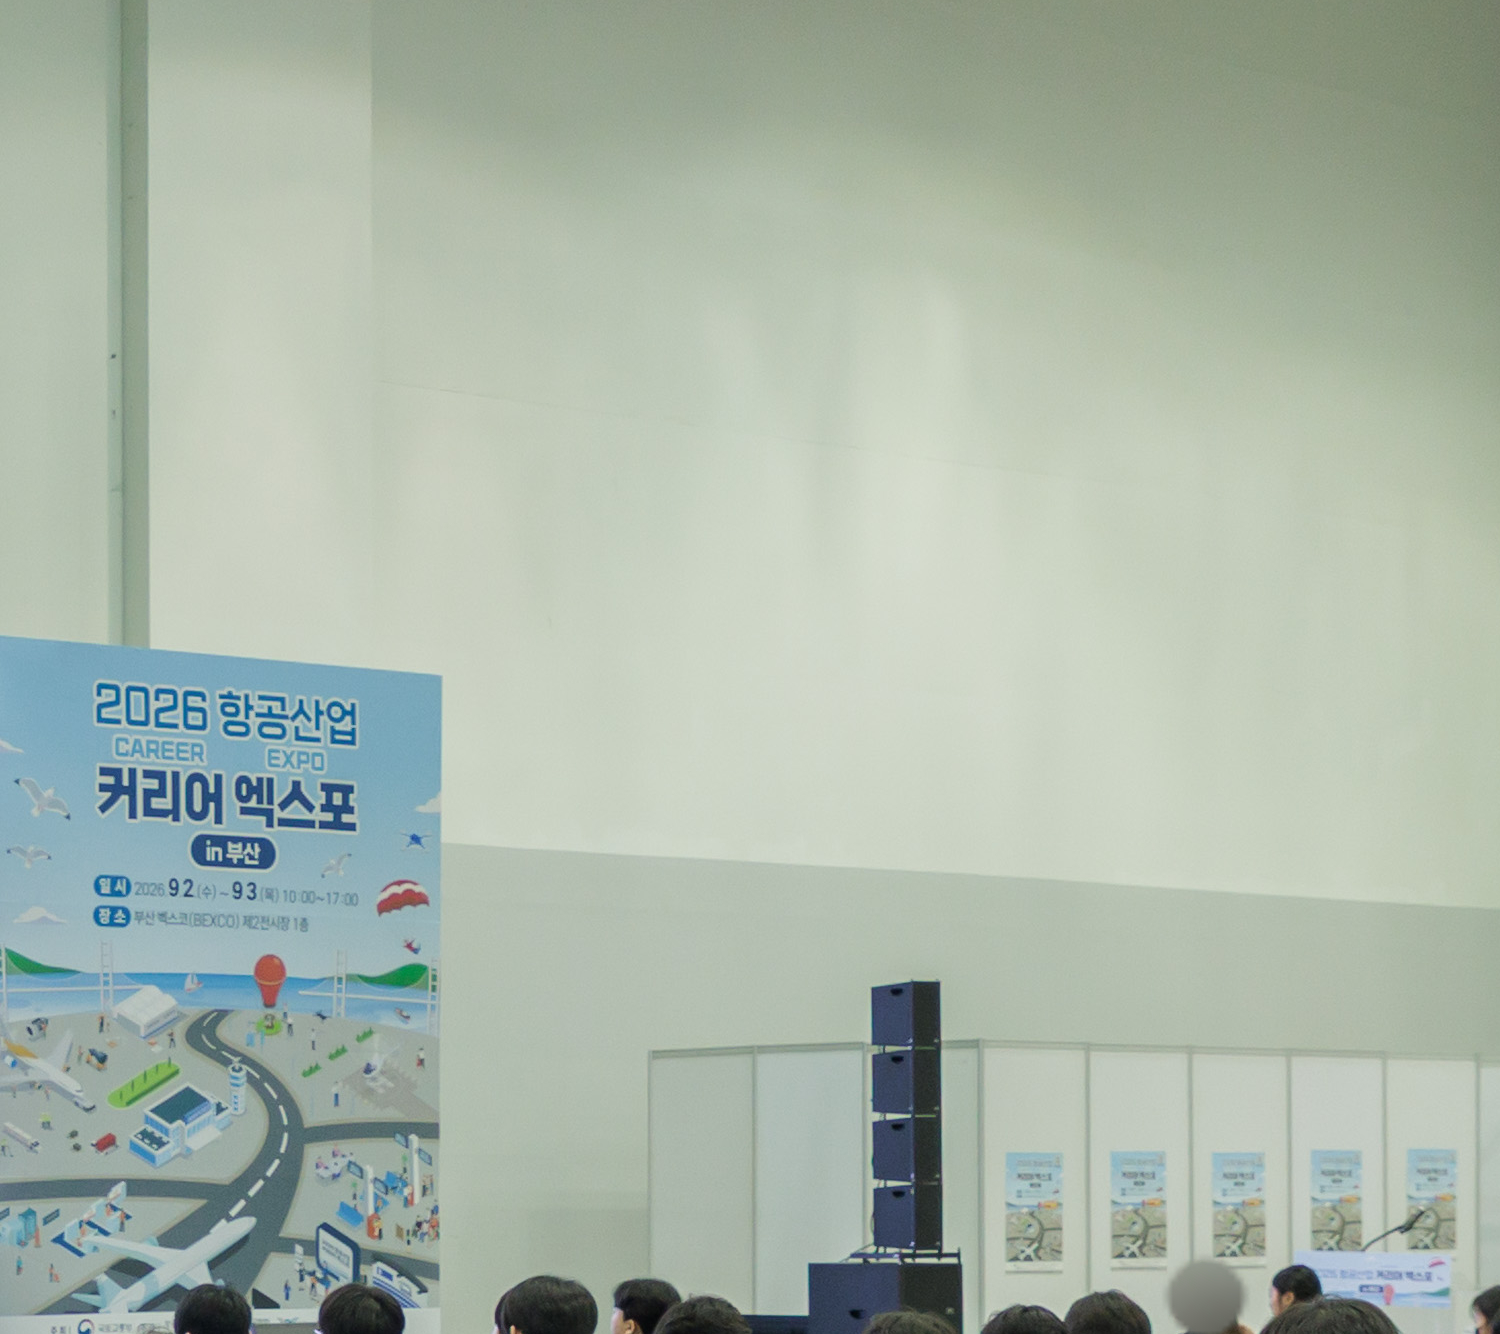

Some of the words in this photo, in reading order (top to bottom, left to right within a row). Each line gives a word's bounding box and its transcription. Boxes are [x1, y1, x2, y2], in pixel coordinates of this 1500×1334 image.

[95, 682, 208, 733] 2026
[217, 690, 358, 747] 항공산업
[114, 736, 205, 763] CAREER
[266, 748, 325, 772] EXPO
[97, 766, 224, 826] 커리어
[234, 774, 358, 833] 엑스포
[205, 839, 224, 863] in
[225, 840, 262, 865] 부산
